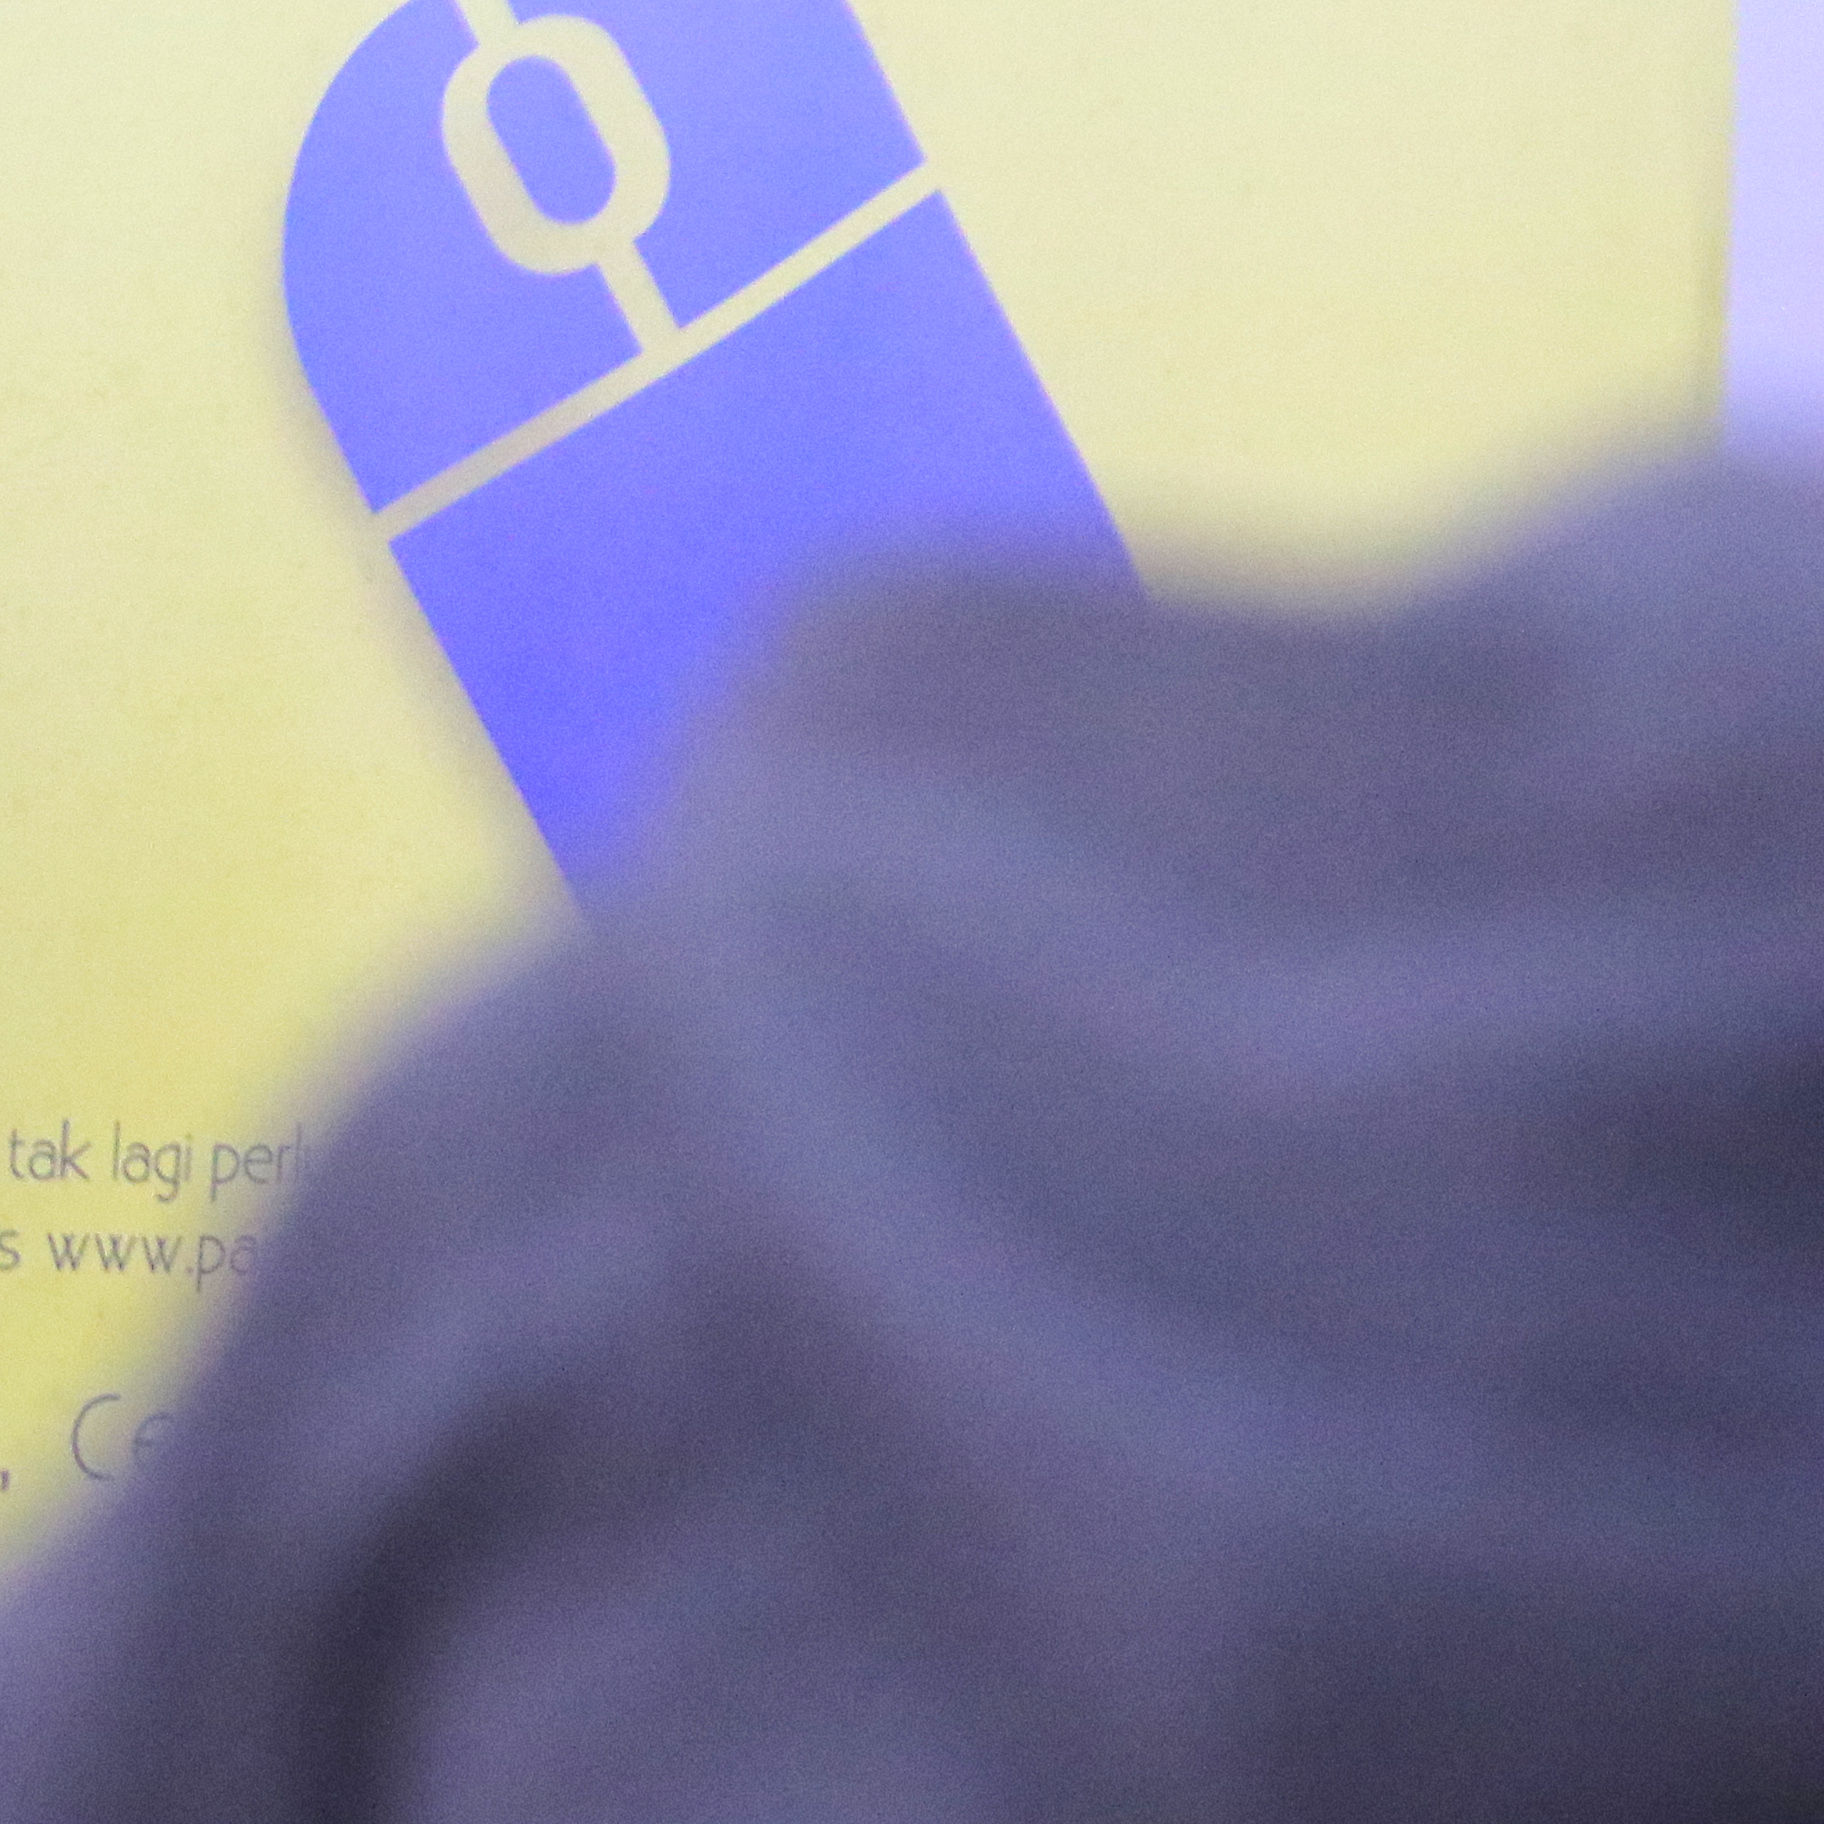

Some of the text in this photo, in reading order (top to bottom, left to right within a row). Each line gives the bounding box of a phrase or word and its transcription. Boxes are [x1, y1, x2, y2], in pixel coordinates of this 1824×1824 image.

[8, 1118, 92, 1180] tak
[111, 1120, 194, 1204] lagi
[207, 1121, 305, 1204] perl
[46, 1232, 260, 1294] www.pa
[71, 1391, 176, 1481] Ce
